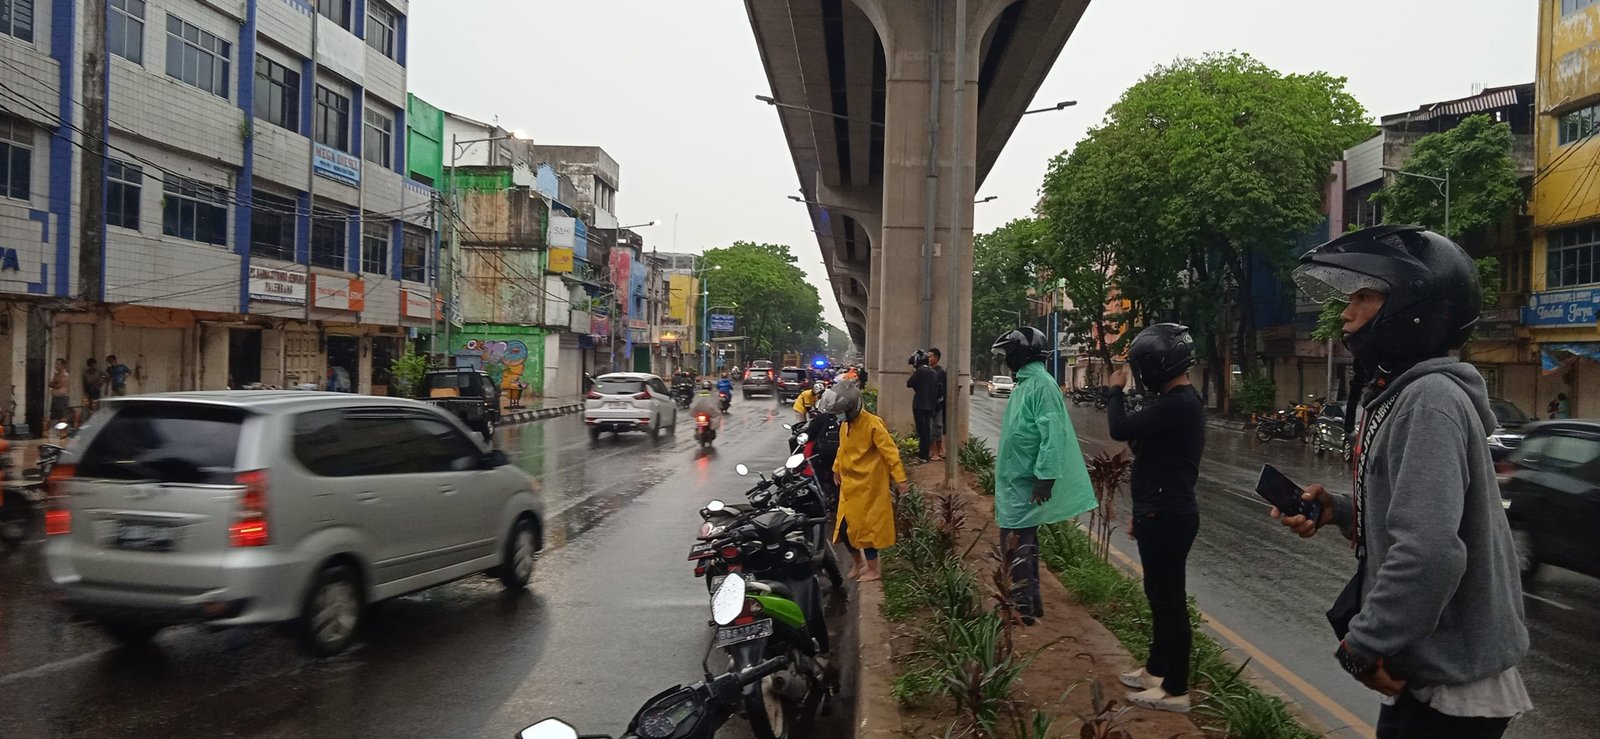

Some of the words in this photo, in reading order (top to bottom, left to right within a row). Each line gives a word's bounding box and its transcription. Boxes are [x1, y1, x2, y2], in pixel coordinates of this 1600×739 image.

[316, 145, 335, 162] MEGA
[338, 152, 358, 171] DIESEL
[265, 281, 293, 294] PALEMBANG
